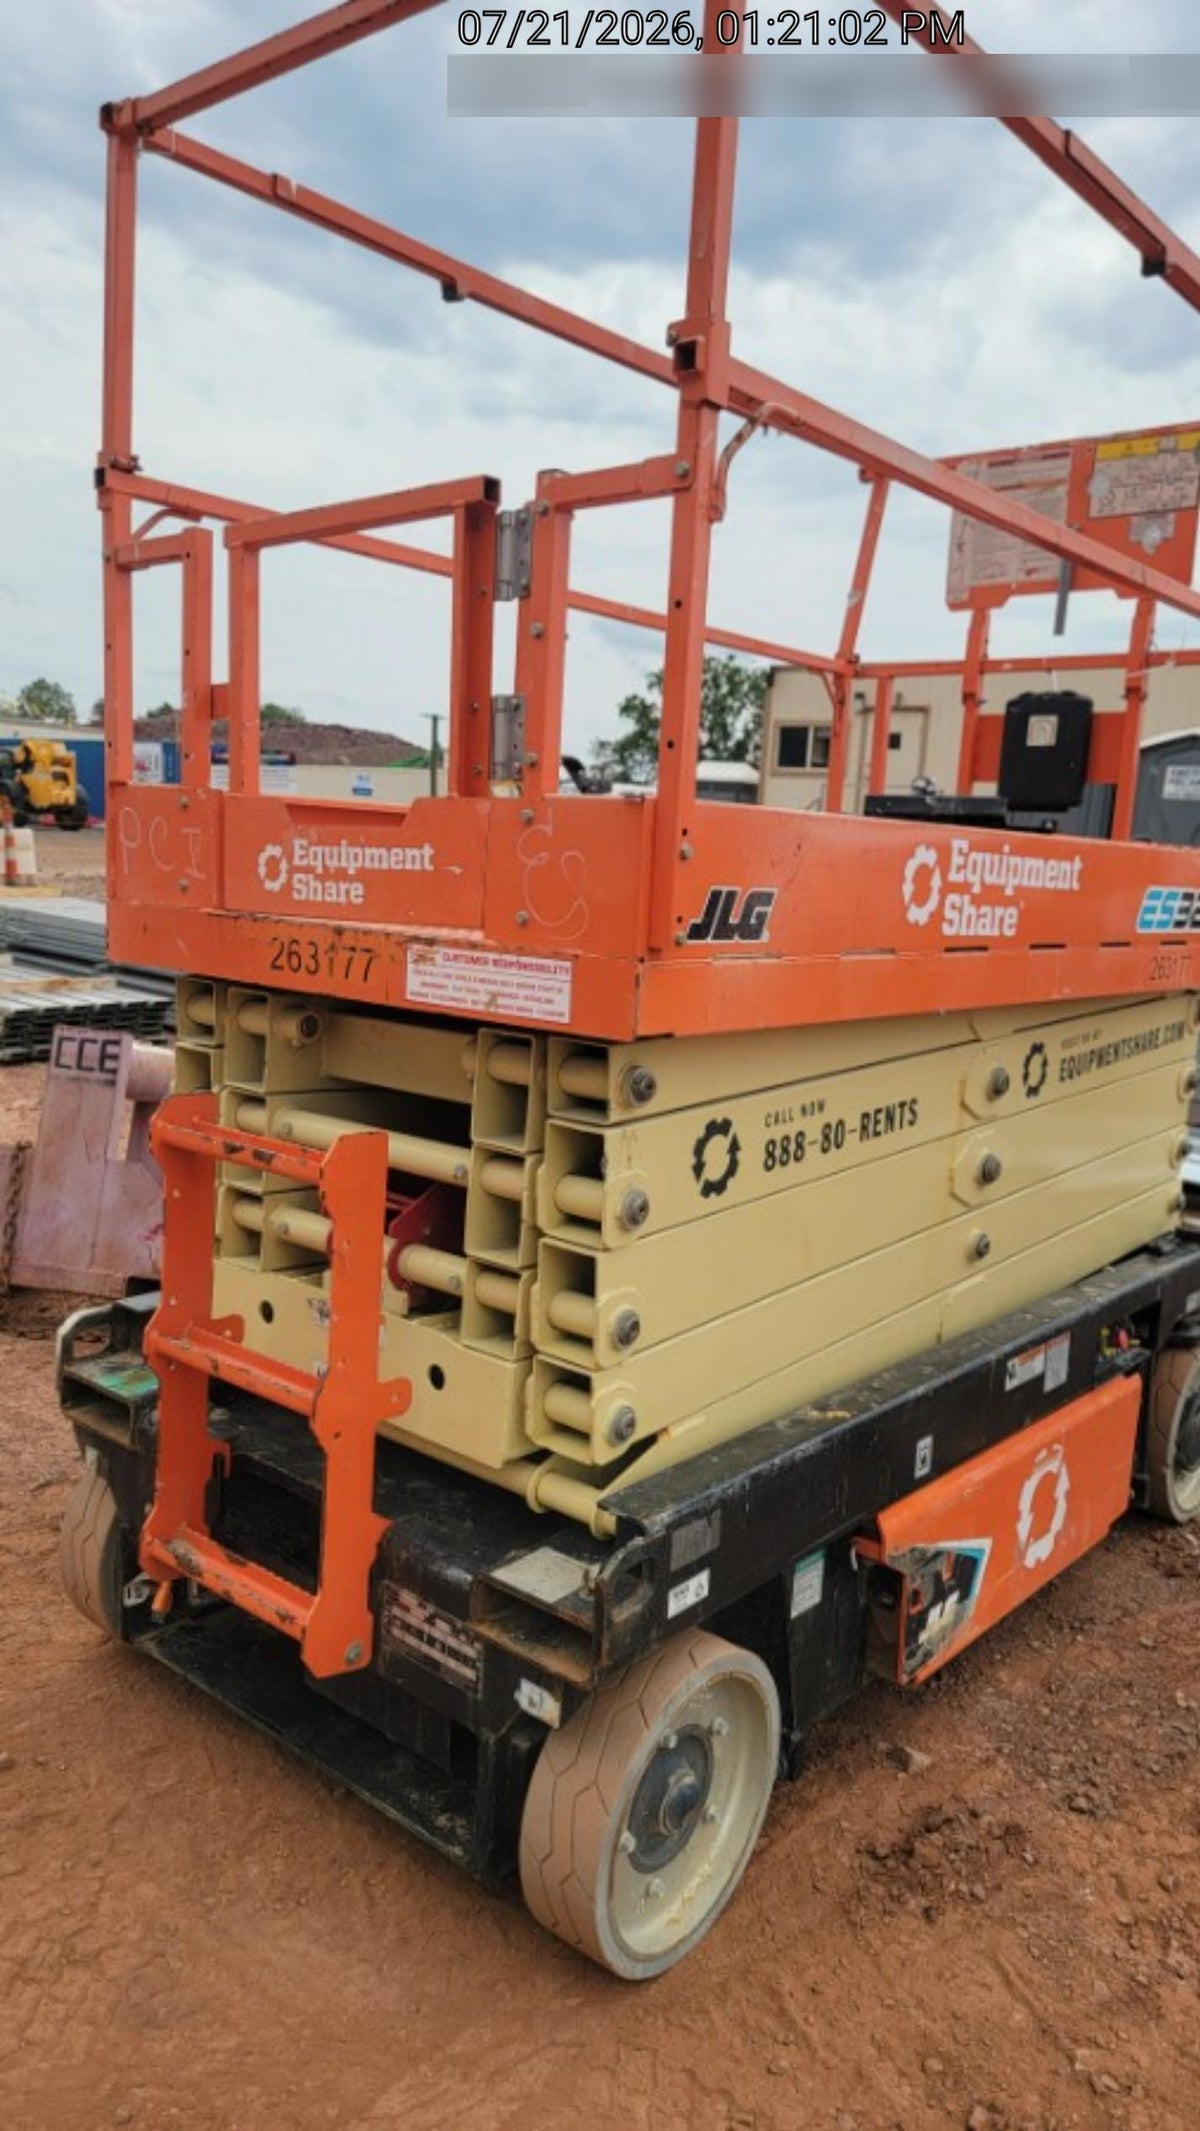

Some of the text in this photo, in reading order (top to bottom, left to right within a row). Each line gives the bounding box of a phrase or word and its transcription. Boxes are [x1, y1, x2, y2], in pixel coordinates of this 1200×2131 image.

[292, 837, 434, 875] Equipment
[947, 838, 1083, 897] Equipment
[291, 873, 365, 905] Share
[686, 885, 777, 943] JLG
[941, 892, 1019, 938] Share
[269, 935, 376, 984] 263177
[54, 1035, 122, 1075] CCE
[1058, 1019, 1187, 1084] EQUIPMENTSHARE.COM
[763, 1097, 919, 1173] 888-80-RENTS
[764, 1099, 826, 1128] CALL NOW
